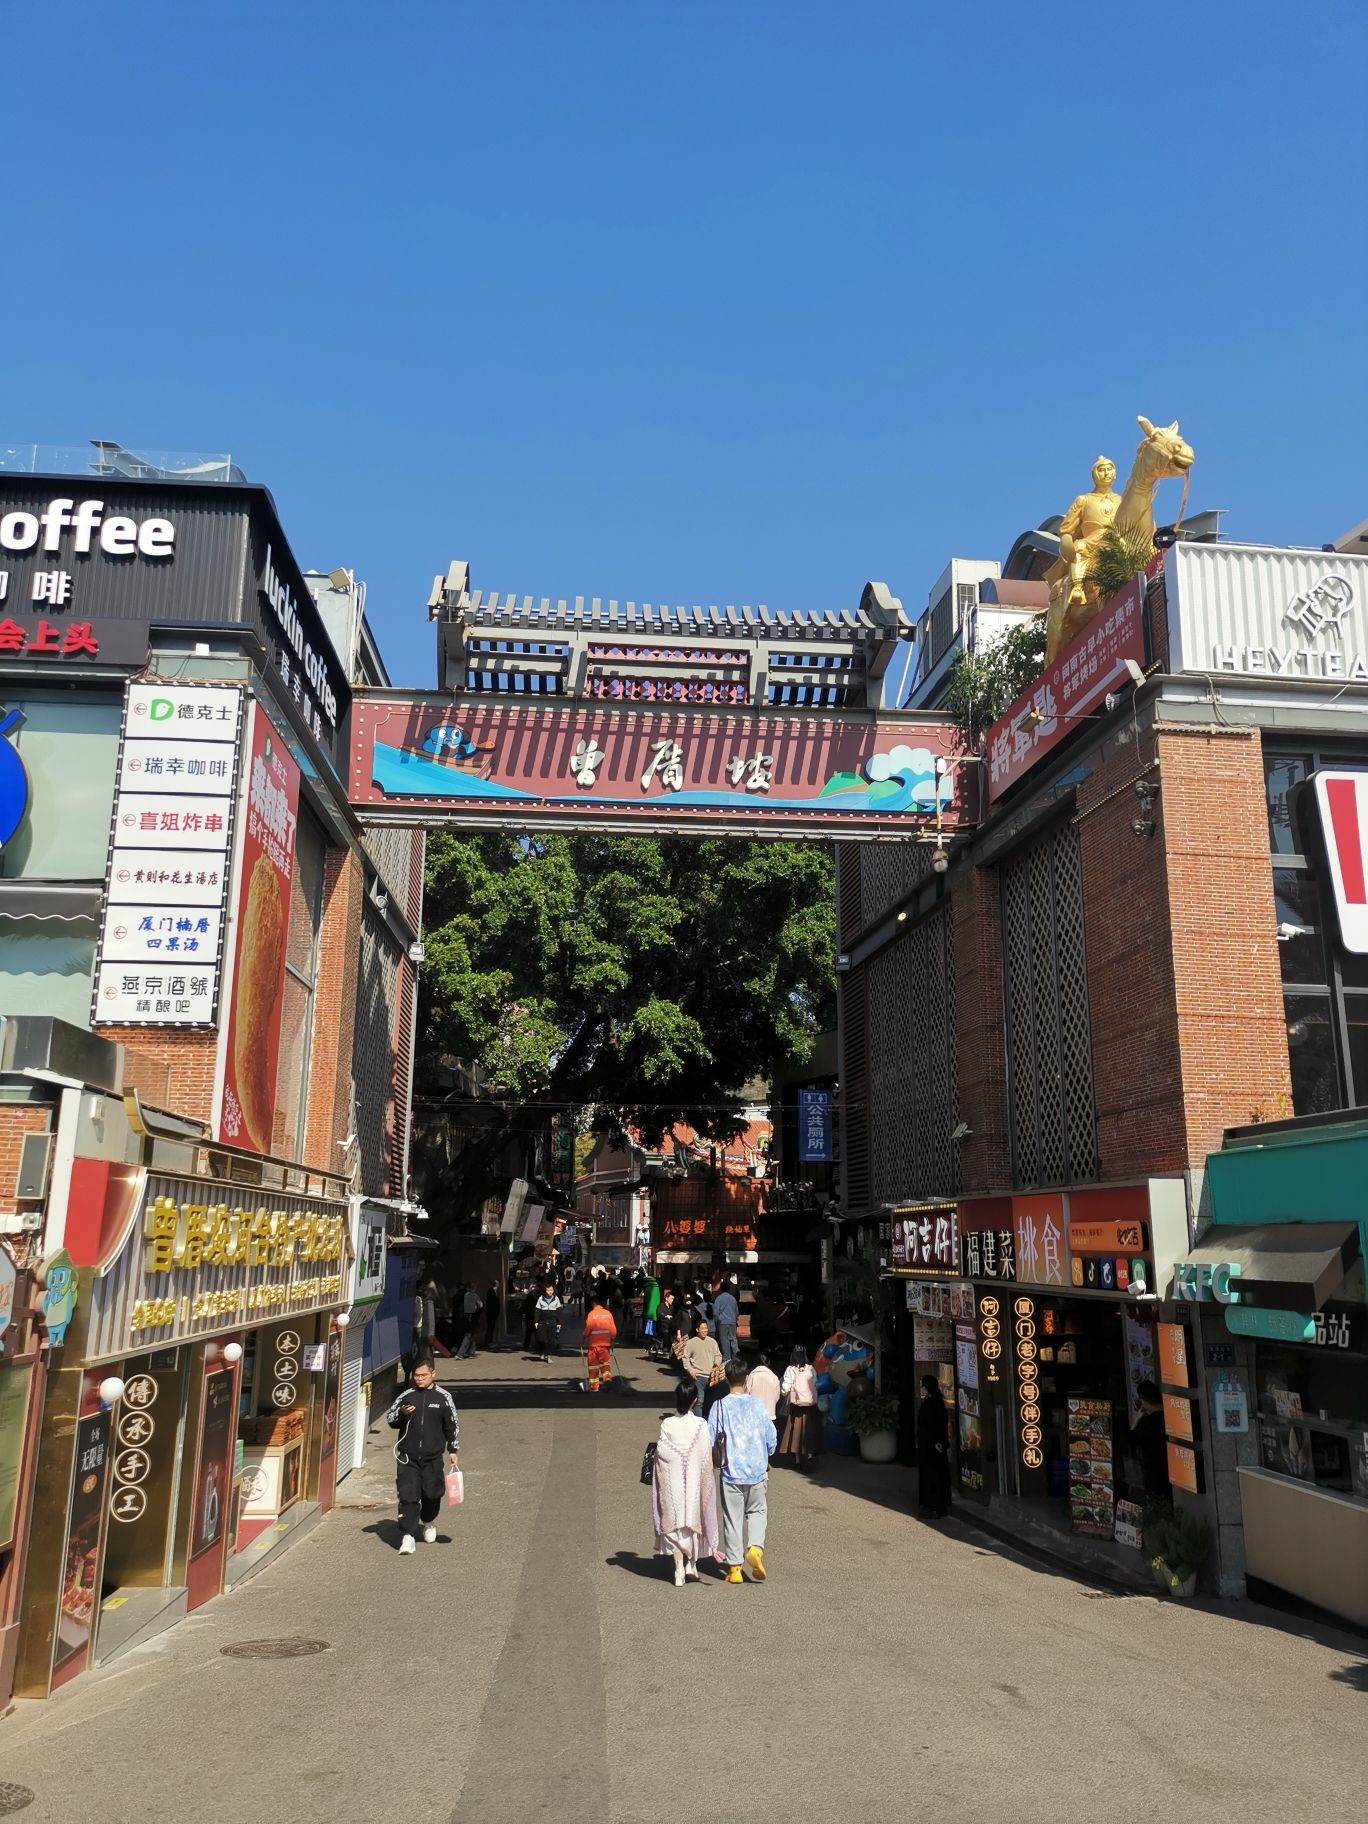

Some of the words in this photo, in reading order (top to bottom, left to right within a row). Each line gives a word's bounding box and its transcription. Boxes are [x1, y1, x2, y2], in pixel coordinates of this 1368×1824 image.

[264, 543, 304, 661] luckin
[304, 641, 337, 728] coffee
[1214, 643, 1368, 679] HEYTEA
[177, 703, 233, 721] 德克士
[143, 757, 229, 778] 瑞幸咖啡
[569, 738, 774, 792] 曾厝垵
[138, 811, 224, 833] 喜姐炸串
[146, 936, 200, 952] 四果汤
[121, 975, 209, 997] 燕京酒號
[135, 999, 191, 1015] 精酿吧
[807, 1104, 825, 1150] 公共厕所
[903, 1216, 950, 1264] 阿吉仔
[966, 1228, 1015, 1280] 福建菜
[1017, 1212, 1063, 1286] 挑食
[1173, 1263, 1241, 1304] KFC
[981, 1297, 1000, 1358] 阿吉仔
[275, 1333, 298, 1404] 本土味
[1017, 1298, 1042, 1467] 厦门老字号伴手礼
[113, 1376, 152, 1515] 傳承手工
